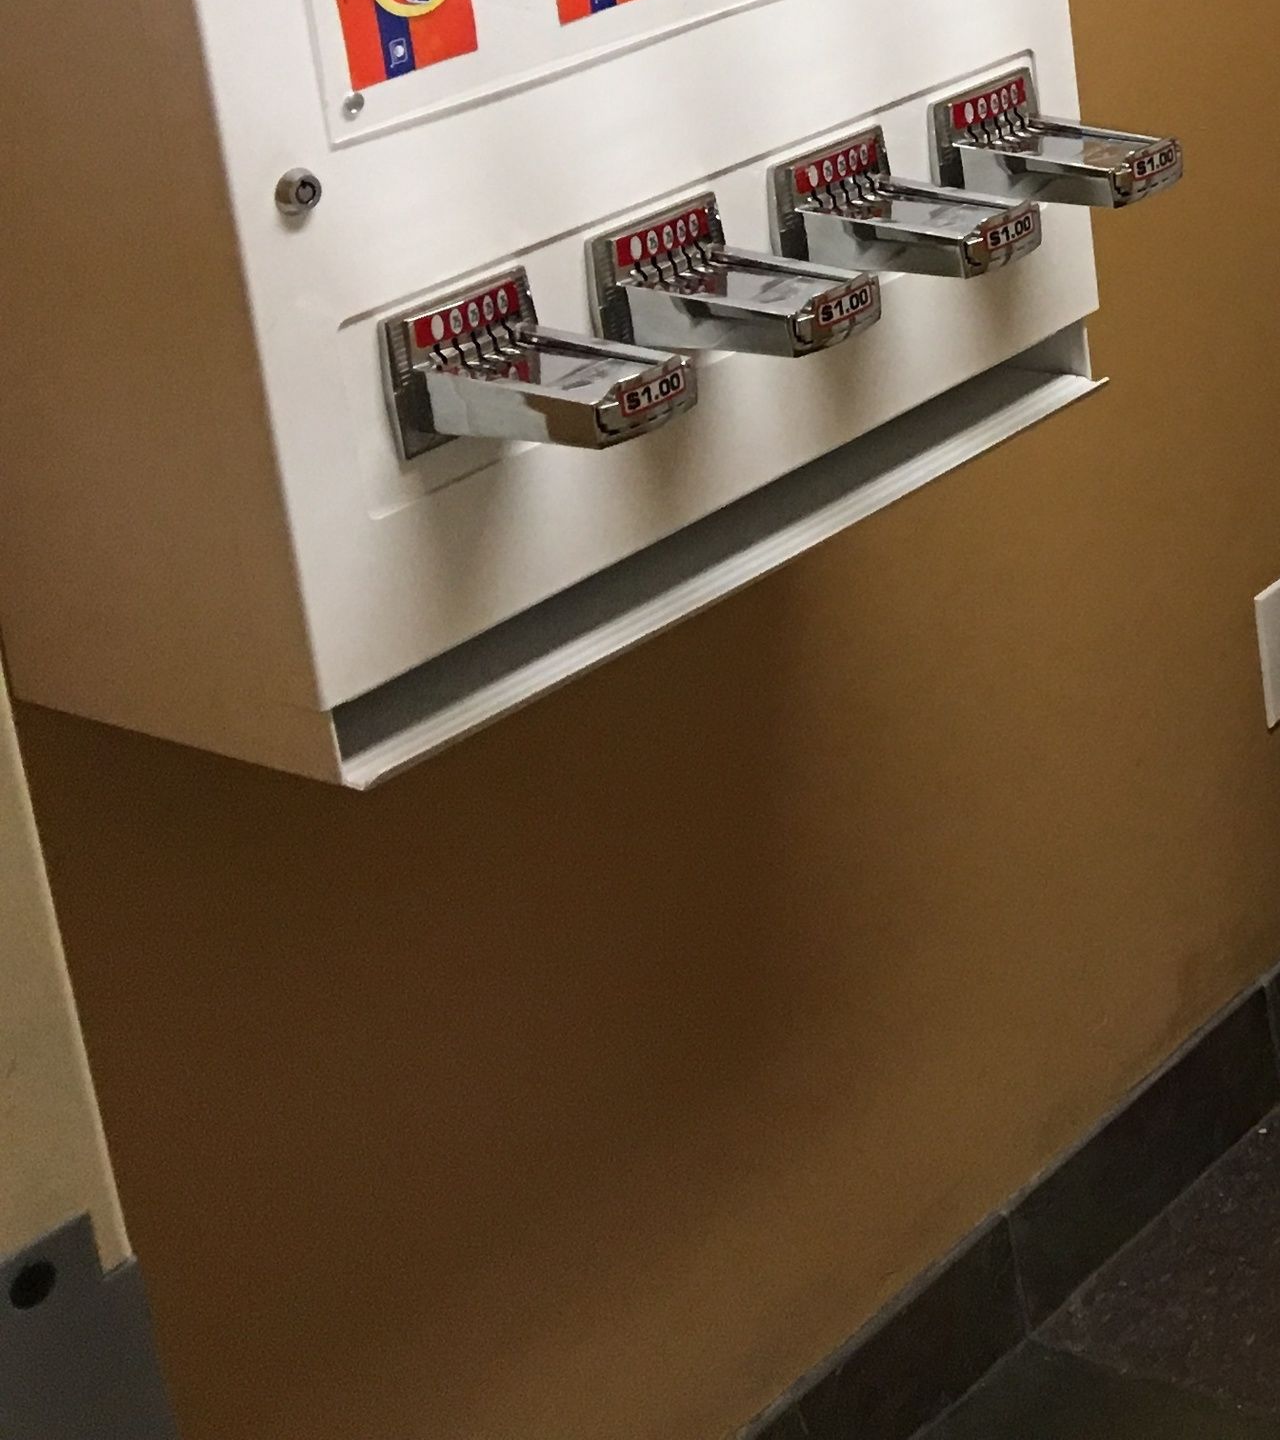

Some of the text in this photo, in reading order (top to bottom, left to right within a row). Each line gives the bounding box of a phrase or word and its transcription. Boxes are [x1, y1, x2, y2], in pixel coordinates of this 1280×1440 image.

[1135, 148, 1174, 176] $1.00
[990, 215, 1031, 247] $1.00
[820, 288, 869, 323] $1.00
[625, 373, 683, 411] $1.00
